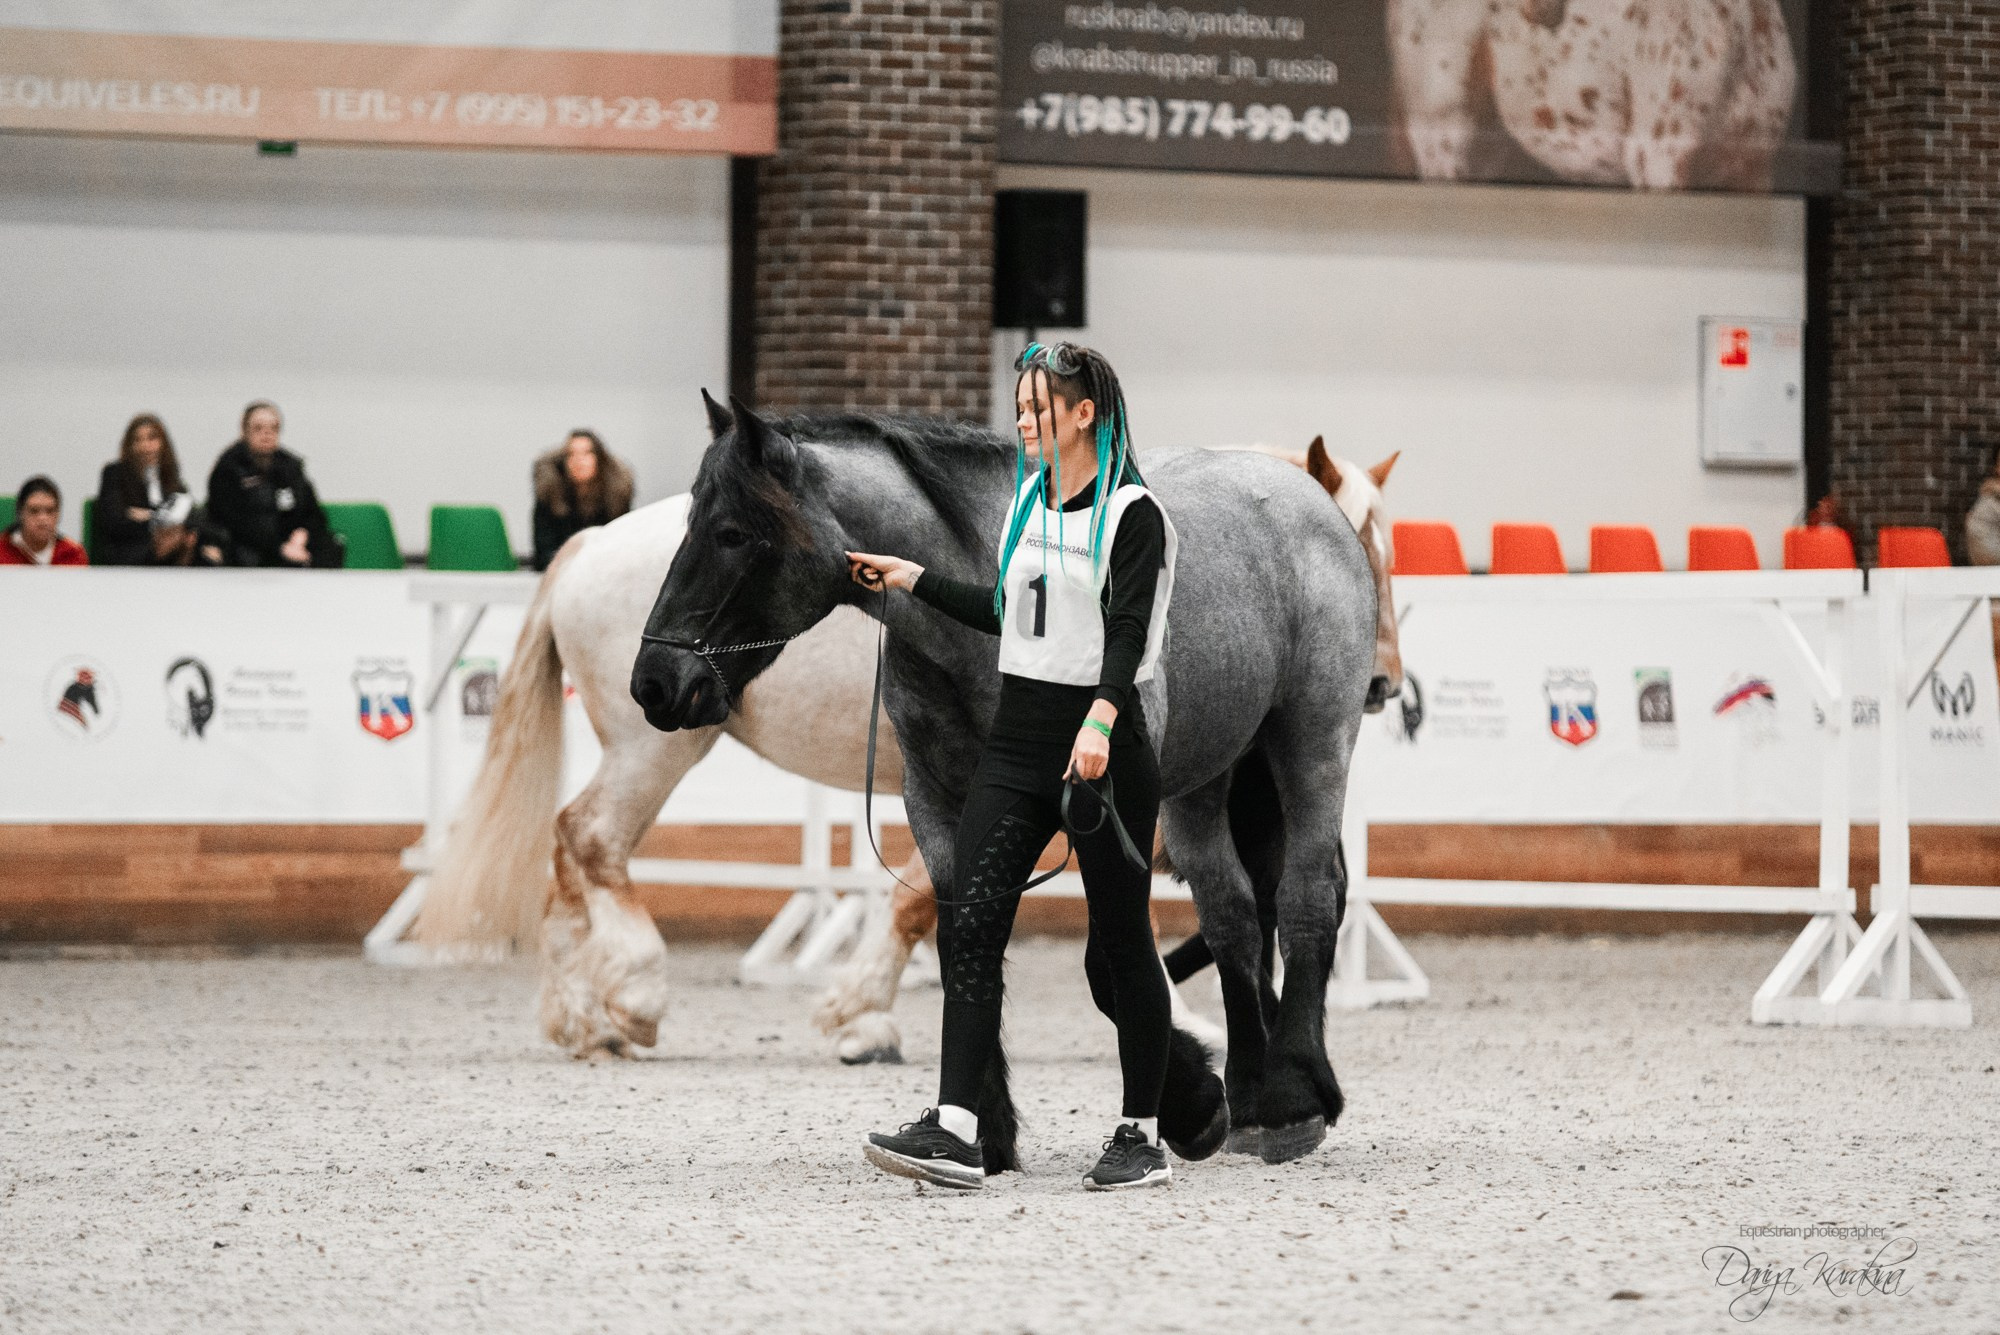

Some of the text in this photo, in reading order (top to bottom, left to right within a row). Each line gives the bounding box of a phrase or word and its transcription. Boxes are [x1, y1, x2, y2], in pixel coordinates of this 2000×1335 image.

[1064, 3, 1305, 41] rusknab@yandex.ru
[1031, 42, 1338, 85] @knabstrupper_in_russia
[409, 91, 450, 123] +7
[455, 92, 548, 129] (995)
[554, 95, 720, 133] 151-23-32
[1166, 98, 1351, 144] 774-99-60
